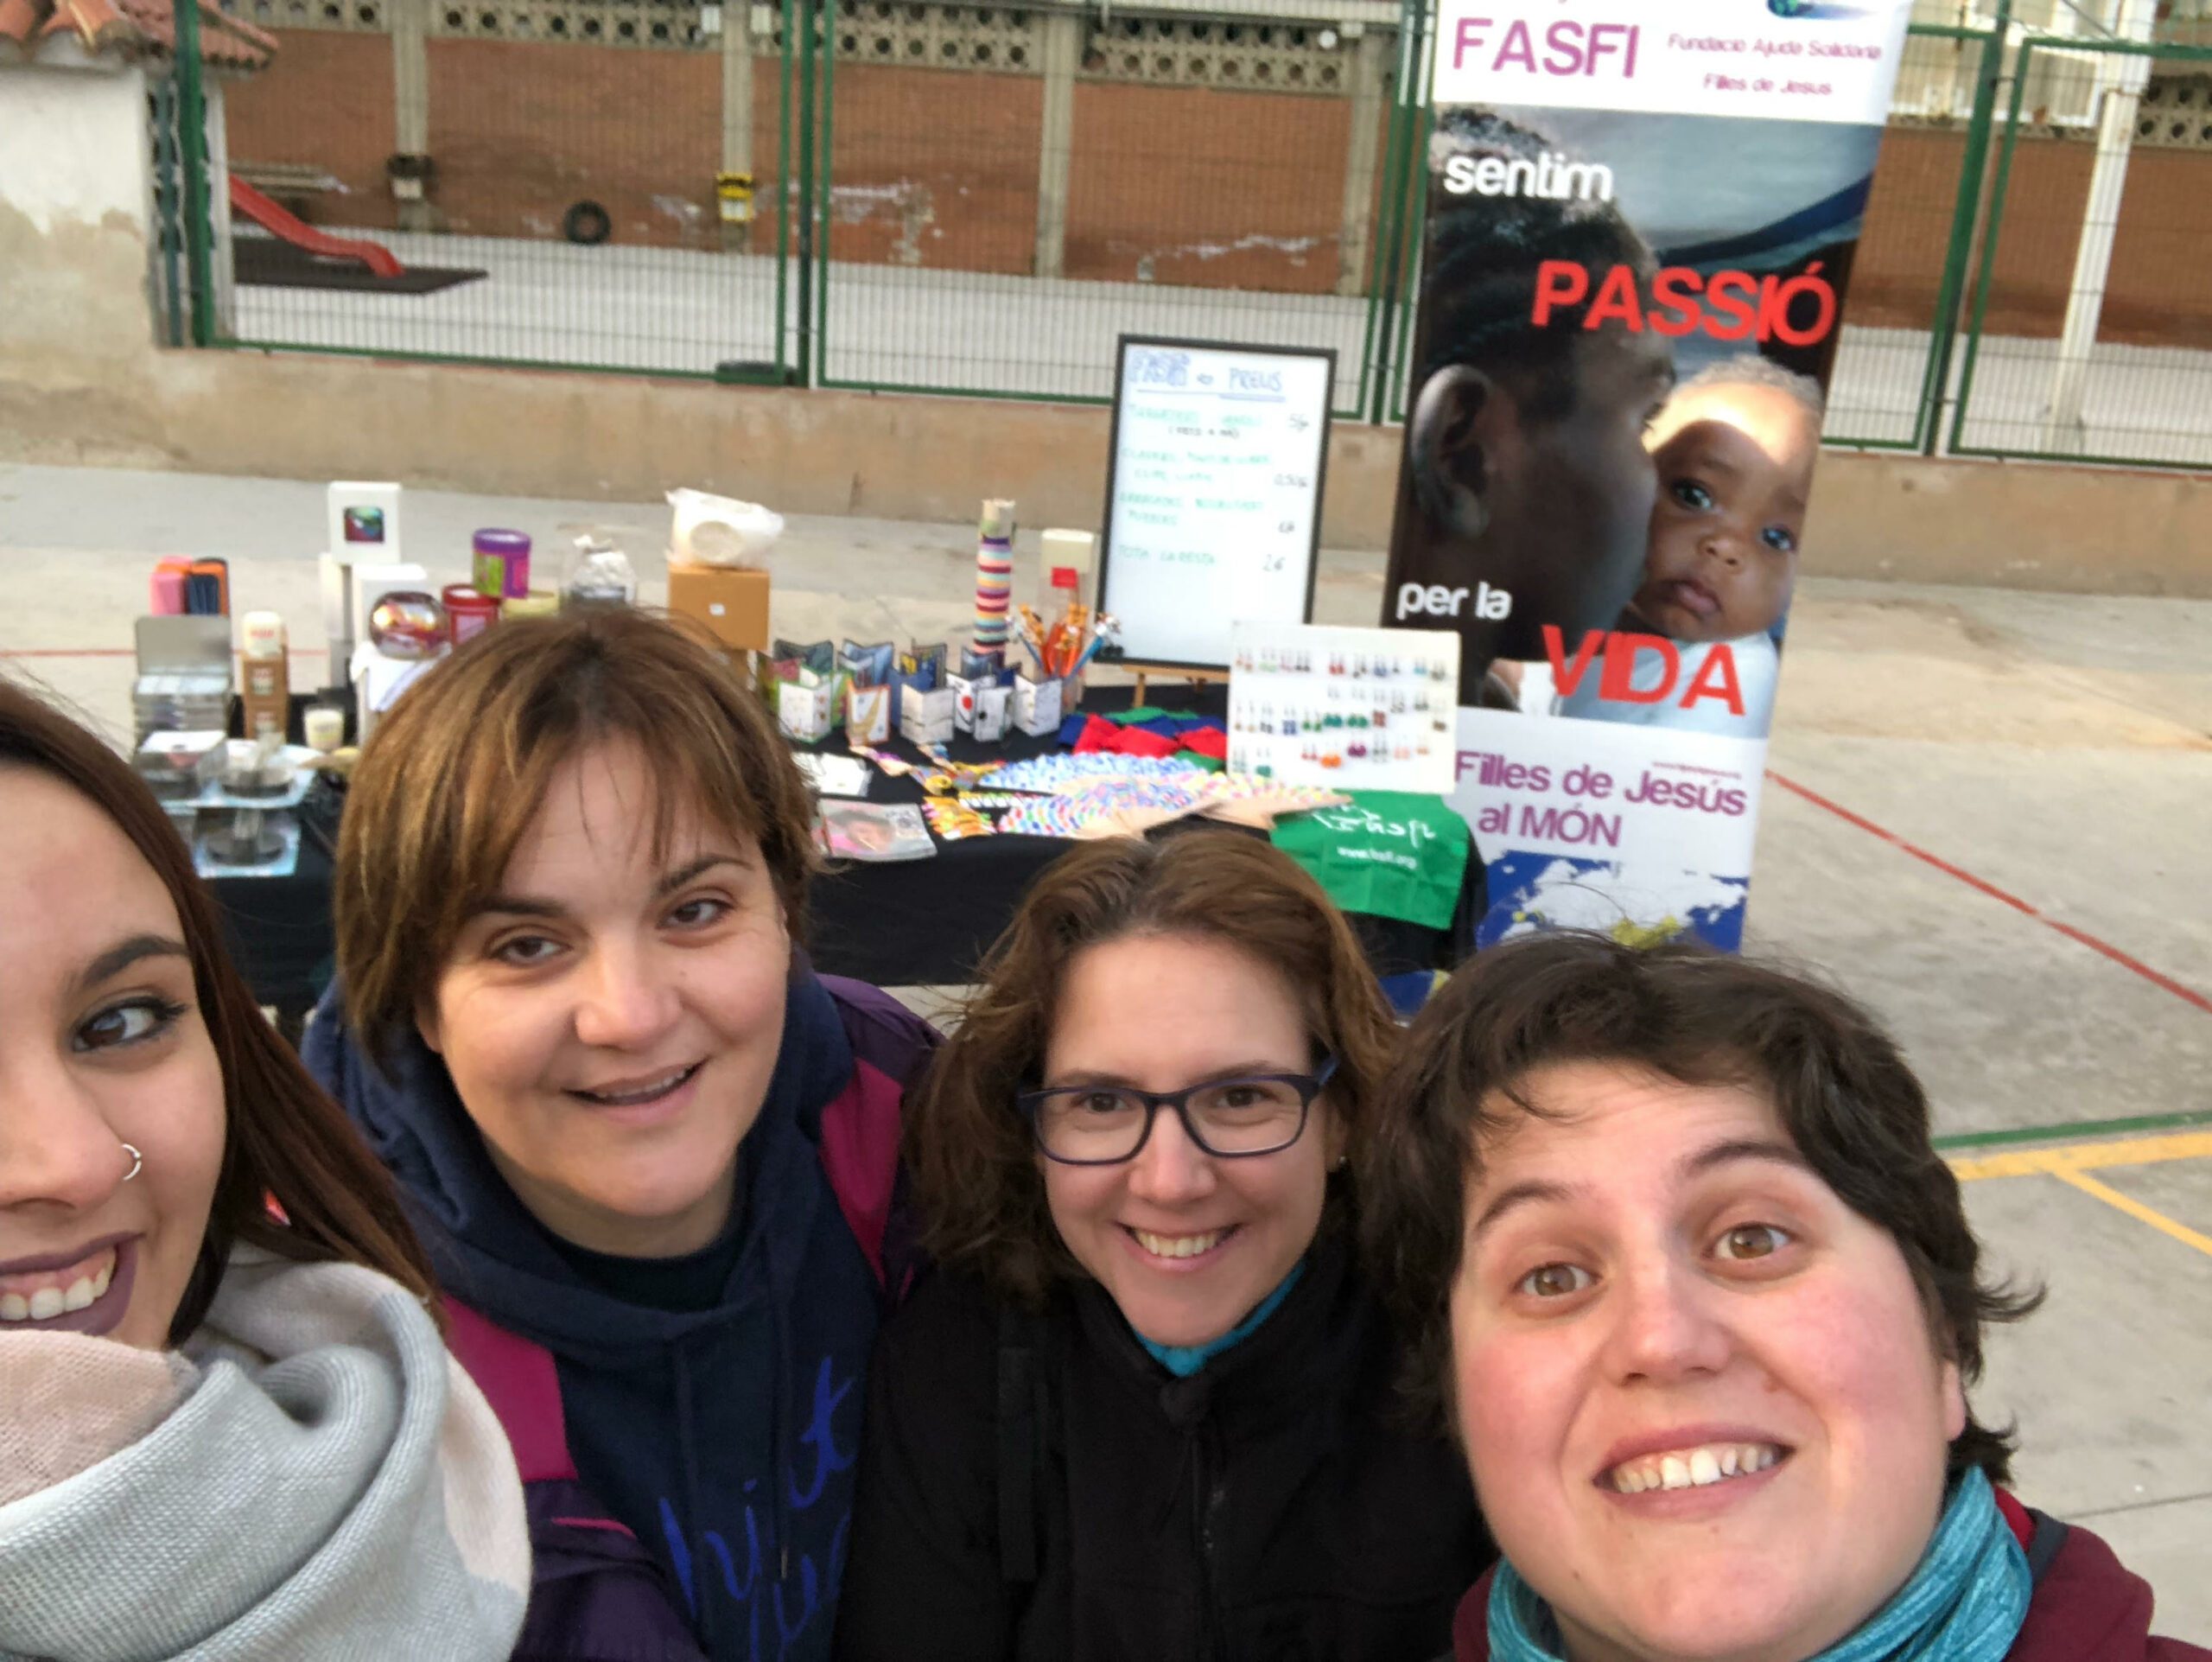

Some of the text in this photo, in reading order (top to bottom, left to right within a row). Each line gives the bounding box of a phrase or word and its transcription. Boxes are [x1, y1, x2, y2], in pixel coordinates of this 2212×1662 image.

[1452, 16, 1640, 80] FASFI
[1703, 72, 1747, 92] Filles
[1752, 77, 1774, 92] de
[1444, 150, 1613, 202] sentim
[1531, 259, 1837, 347] PASSIÓ
[1228, 366, 1284, 392] PREUS
[1395, 582, 1513, 621] per la
[1541, 624, 1746, 716] VIDA
[1456, 749, 1551, 793] Filles
[1562, 763, 1614, 800] de
[1625, 769, 1748, 818] Jesús
[1478, 801, 1623, 849] al MÓN
